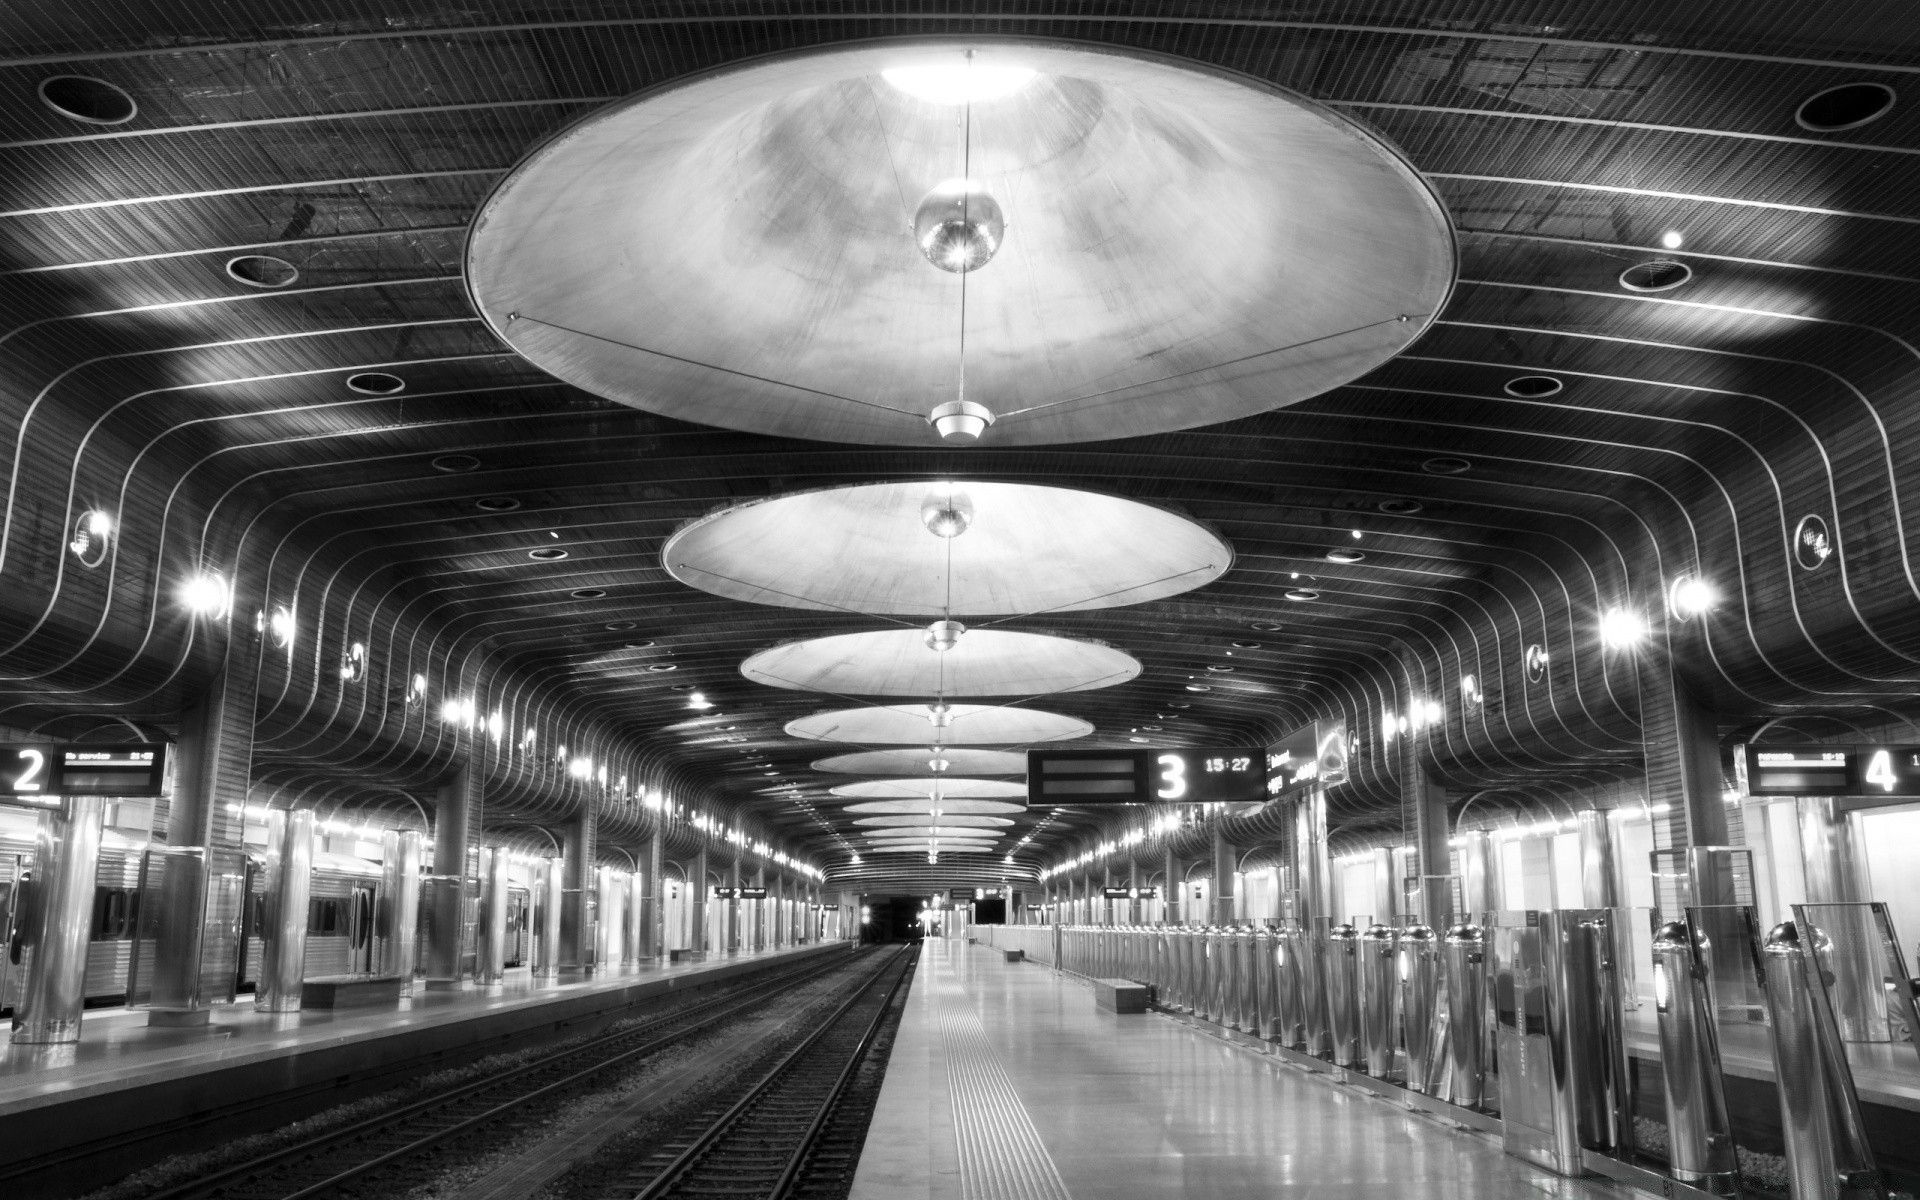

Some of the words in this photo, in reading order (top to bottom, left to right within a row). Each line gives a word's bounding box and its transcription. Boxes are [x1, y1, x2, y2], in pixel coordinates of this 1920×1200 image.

[13, 749, 44, 791] 2
[1158, 754, 1186, 799] 3
[1205, 757, 1251, 772] 15:27
[1866, 750, 1897, 792] 4
[733, 887, 741, 899] 2
